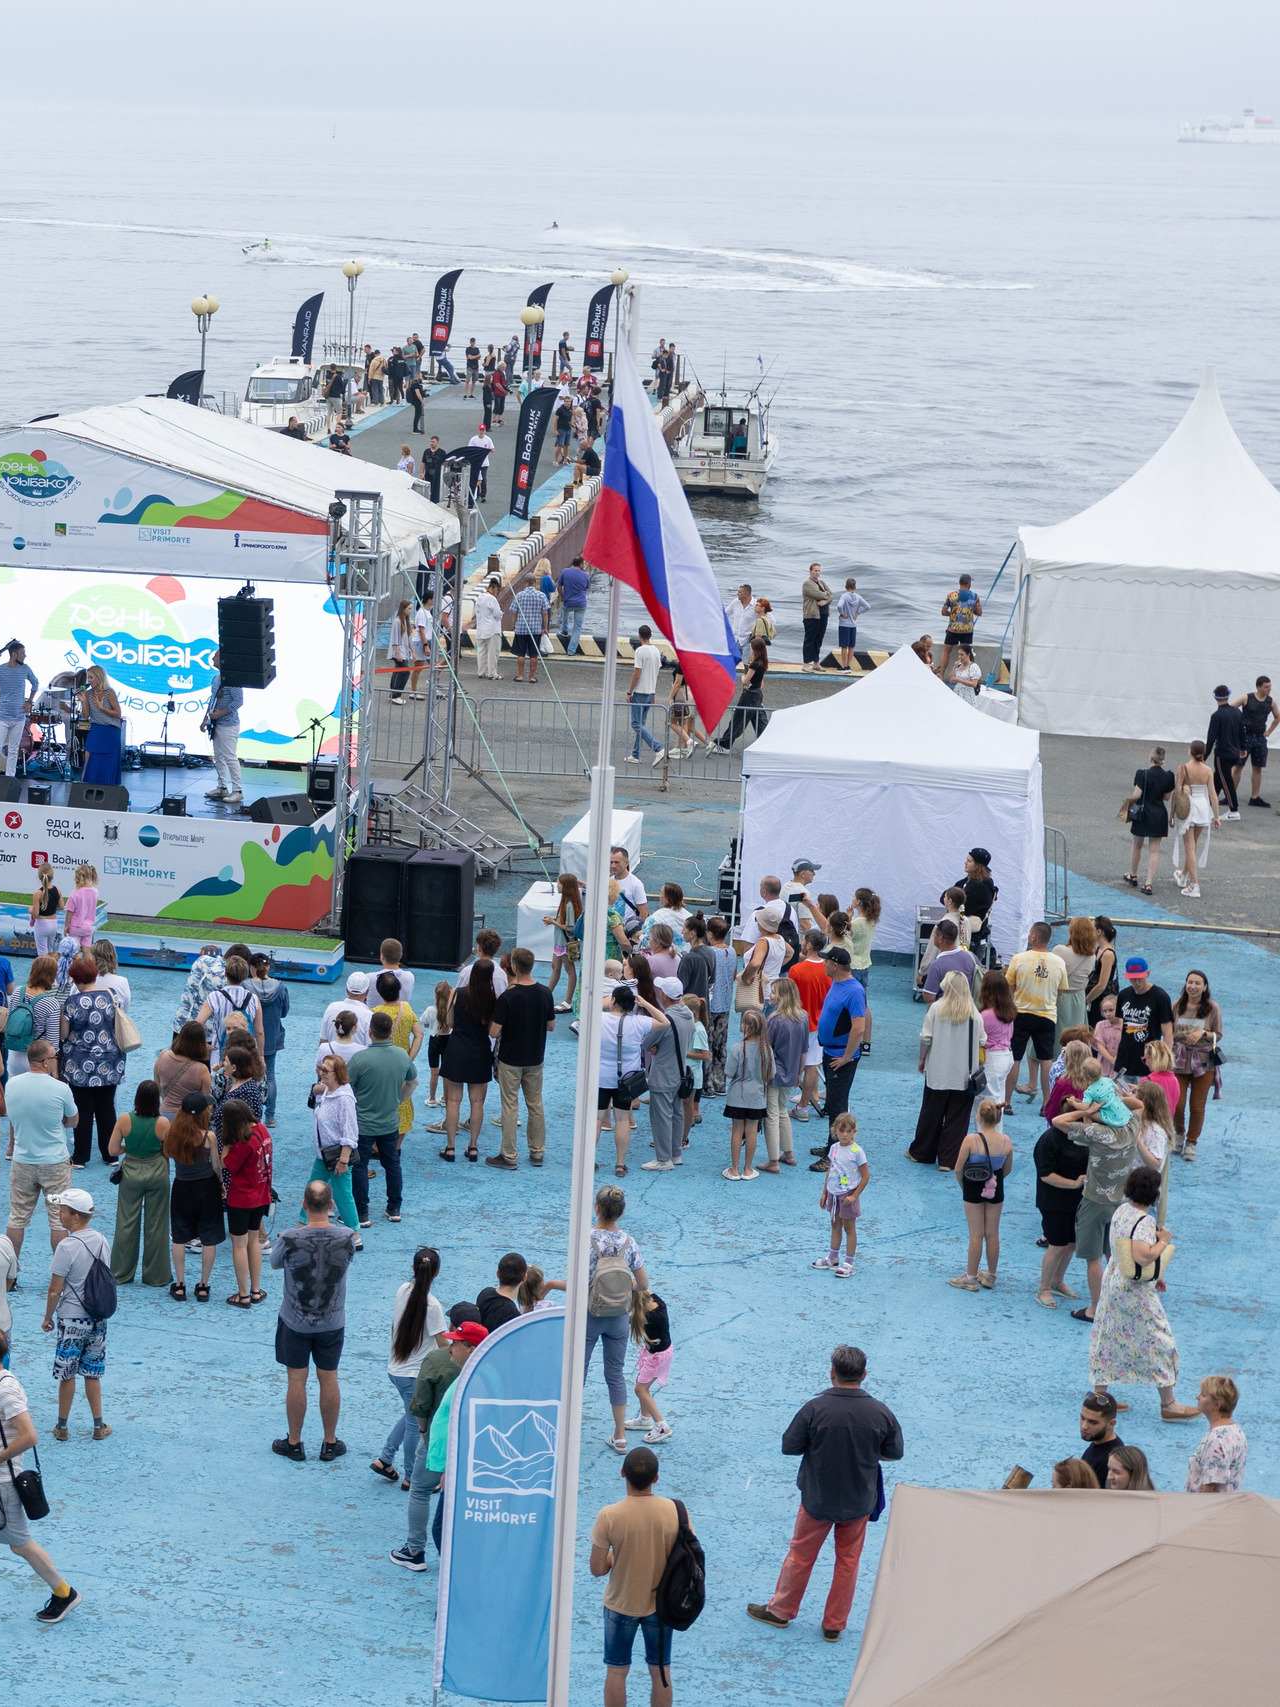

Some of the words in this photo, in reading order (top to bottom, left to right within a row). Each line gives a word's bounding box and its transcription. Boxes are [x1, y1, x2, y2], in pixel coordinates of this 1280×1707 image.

[435, 287, 448, 323] Водник
[590, 303, 602, 339] Водник
[522, 408, 536, 461] Водник
[62, 479, 82, 499] 2025
[152, 535, 191, 544] PRIMORYE
[46, 818, 69, 829] еда
[74, 821, 81, 829] и
[46, 828, 84, 840] точка.
[52, 853, 89, 866] Водник
[122, 857, 149, 868] VISIT
[122, 867, 176, 880] PRIMORYE
[466, 1497, 502, 1510] VISIT
[464, 1510, 537, 1525] PRIMORYE
